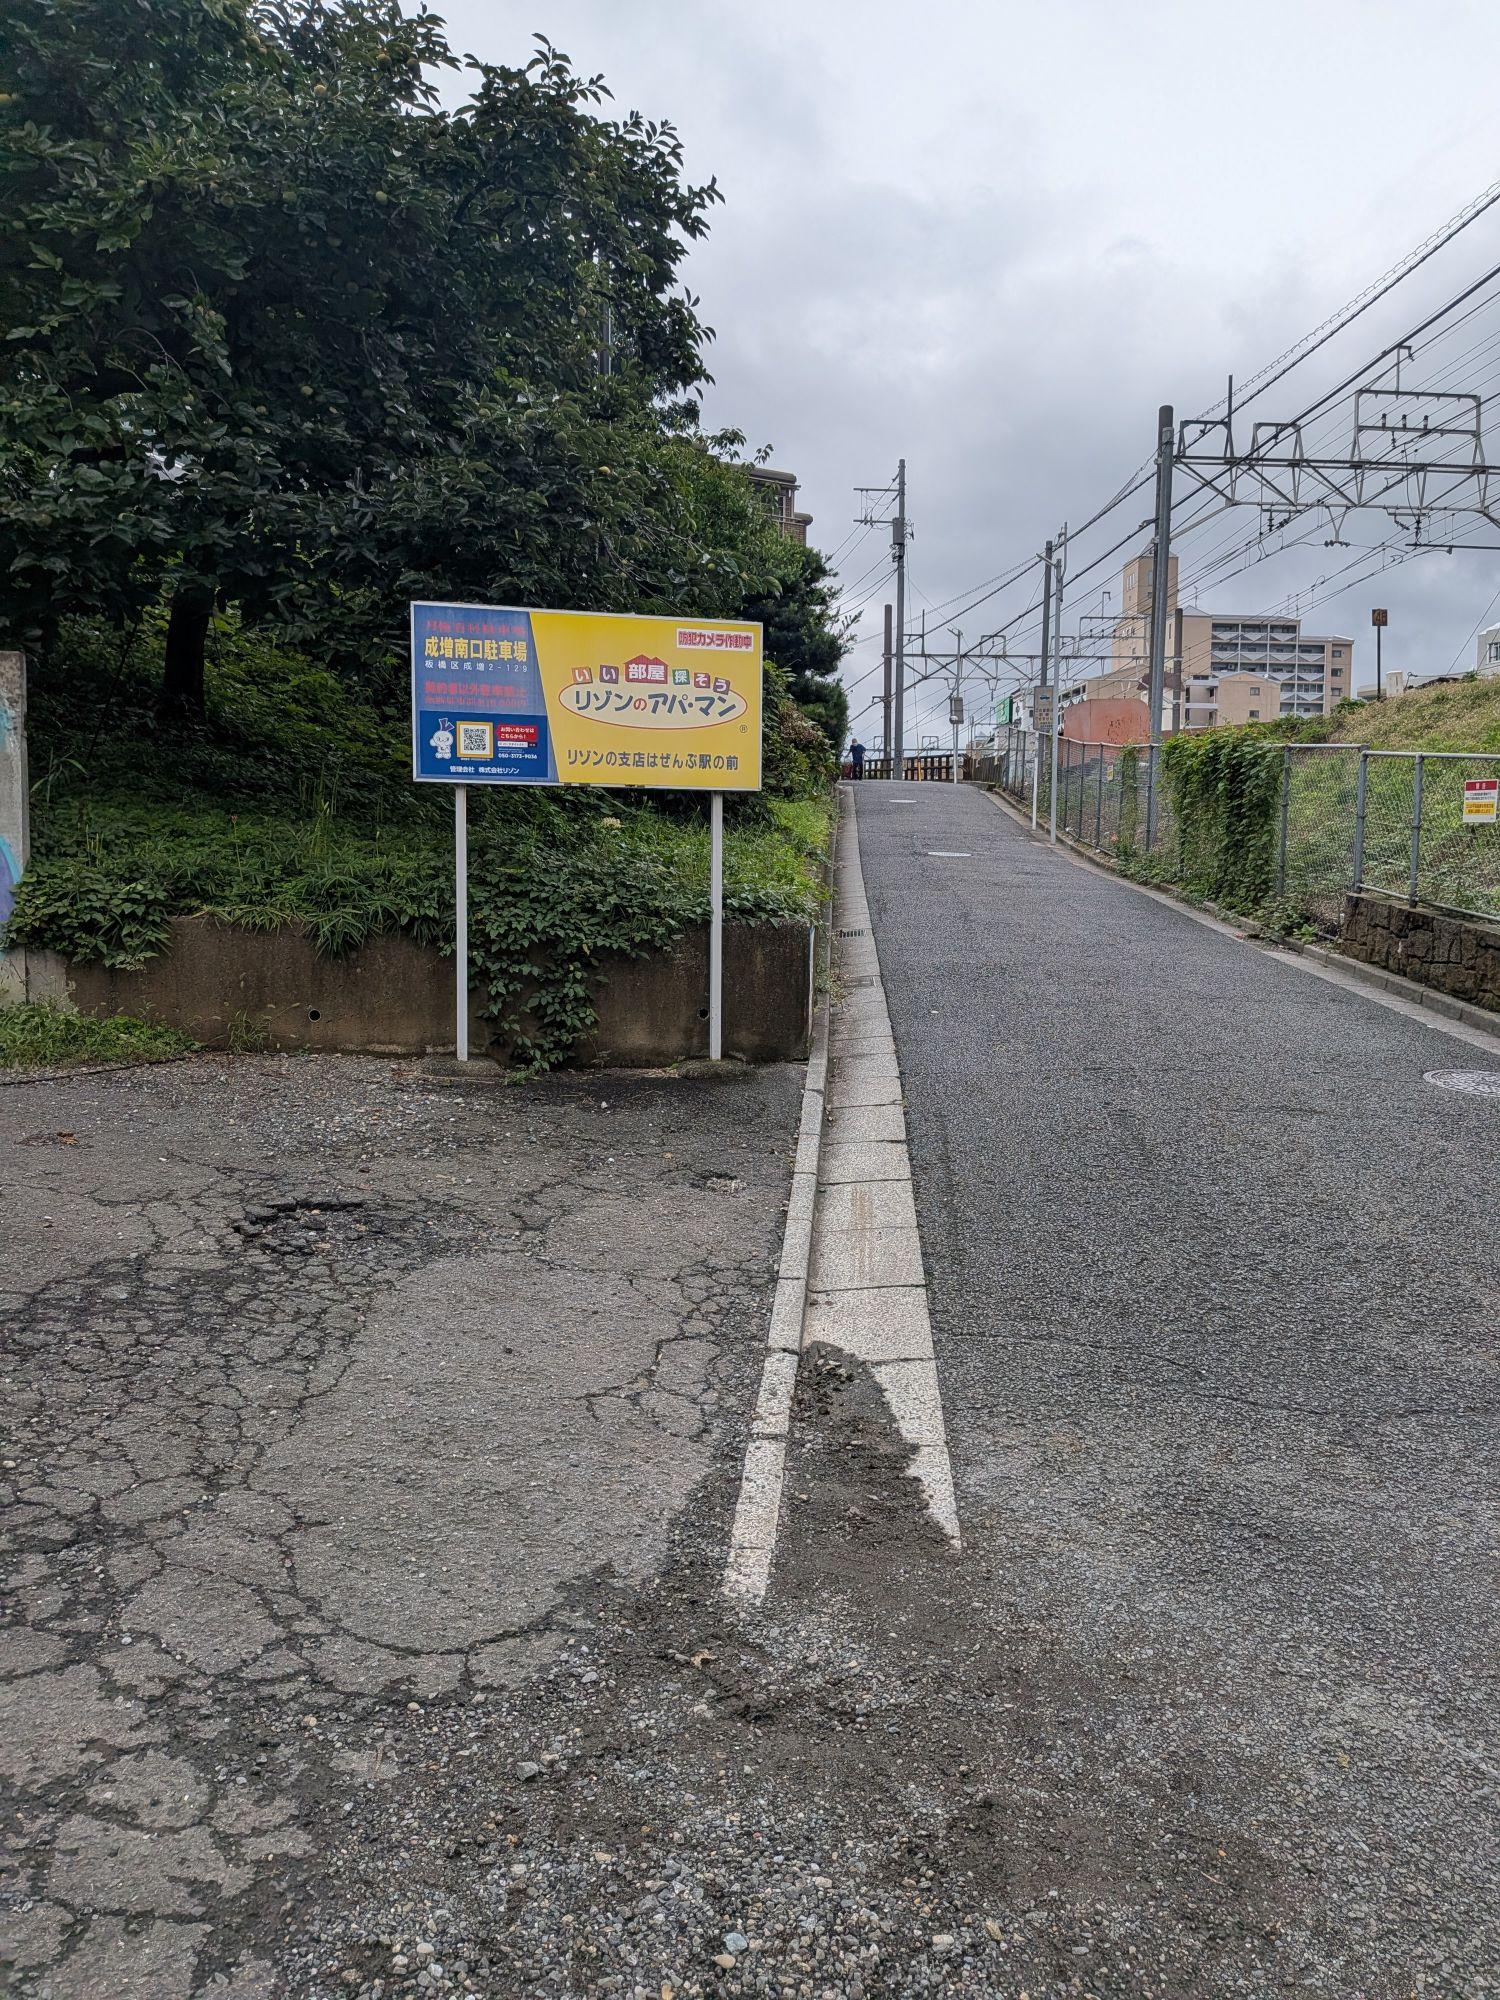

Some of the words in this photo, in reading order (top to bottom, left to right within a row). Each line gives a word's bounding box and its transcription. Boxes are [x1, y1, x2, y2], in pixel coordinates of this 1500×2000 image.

[424, 636, 527, 662] 成増南口駐車場
[678, 631, 753, 649] 防犯カメラ作動中
[574, 663, 729, 692] いい部屋探そう
[576, 690, 736, 717] リゾンのアパ・マン
[449, 766, 475, 774] 管理会社
[478, 766, 520, 775] 株式会社リゾン
[567, 750, 739, 771] リゾンの支店はぜんぶ駅の前
